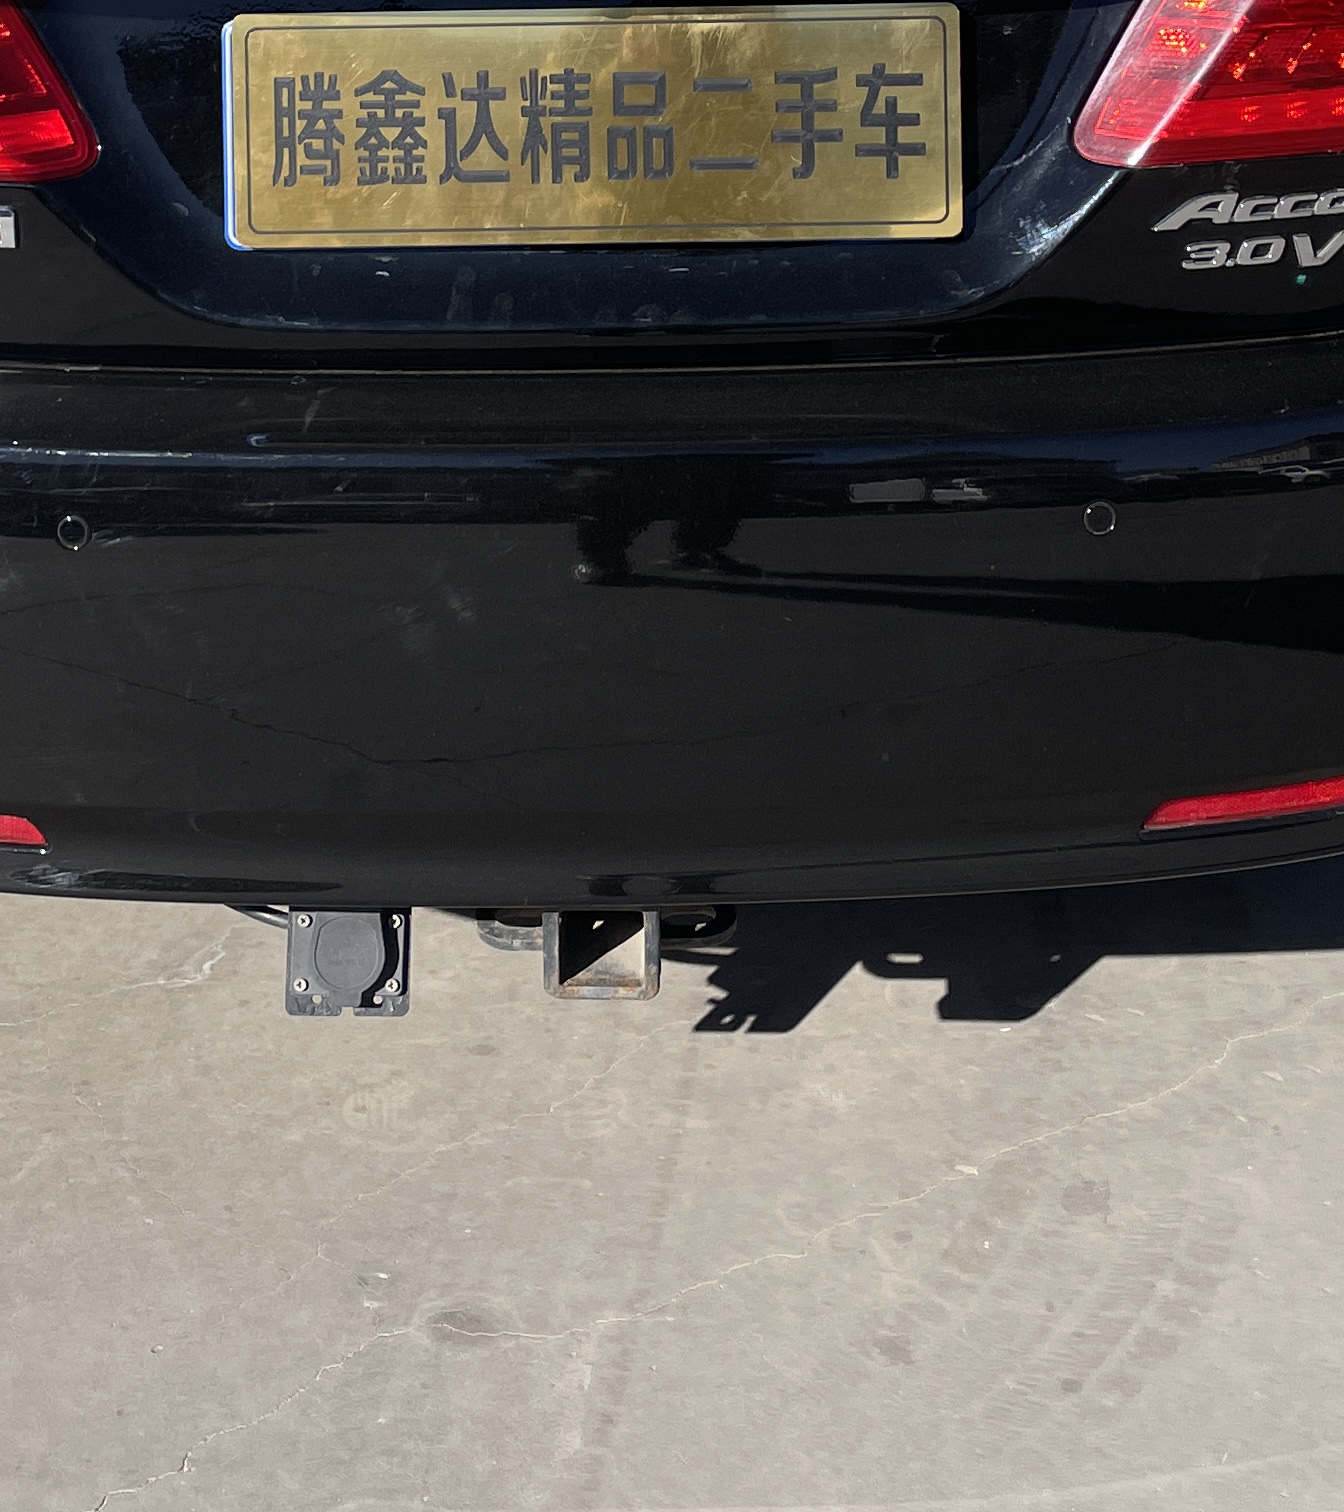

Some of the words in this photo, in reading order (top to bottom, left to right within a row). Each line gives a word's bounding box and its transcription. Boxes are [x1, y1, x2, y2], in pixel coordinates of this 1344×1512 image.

[271, 61, 927, 186] 腾鑫达精品二手车
